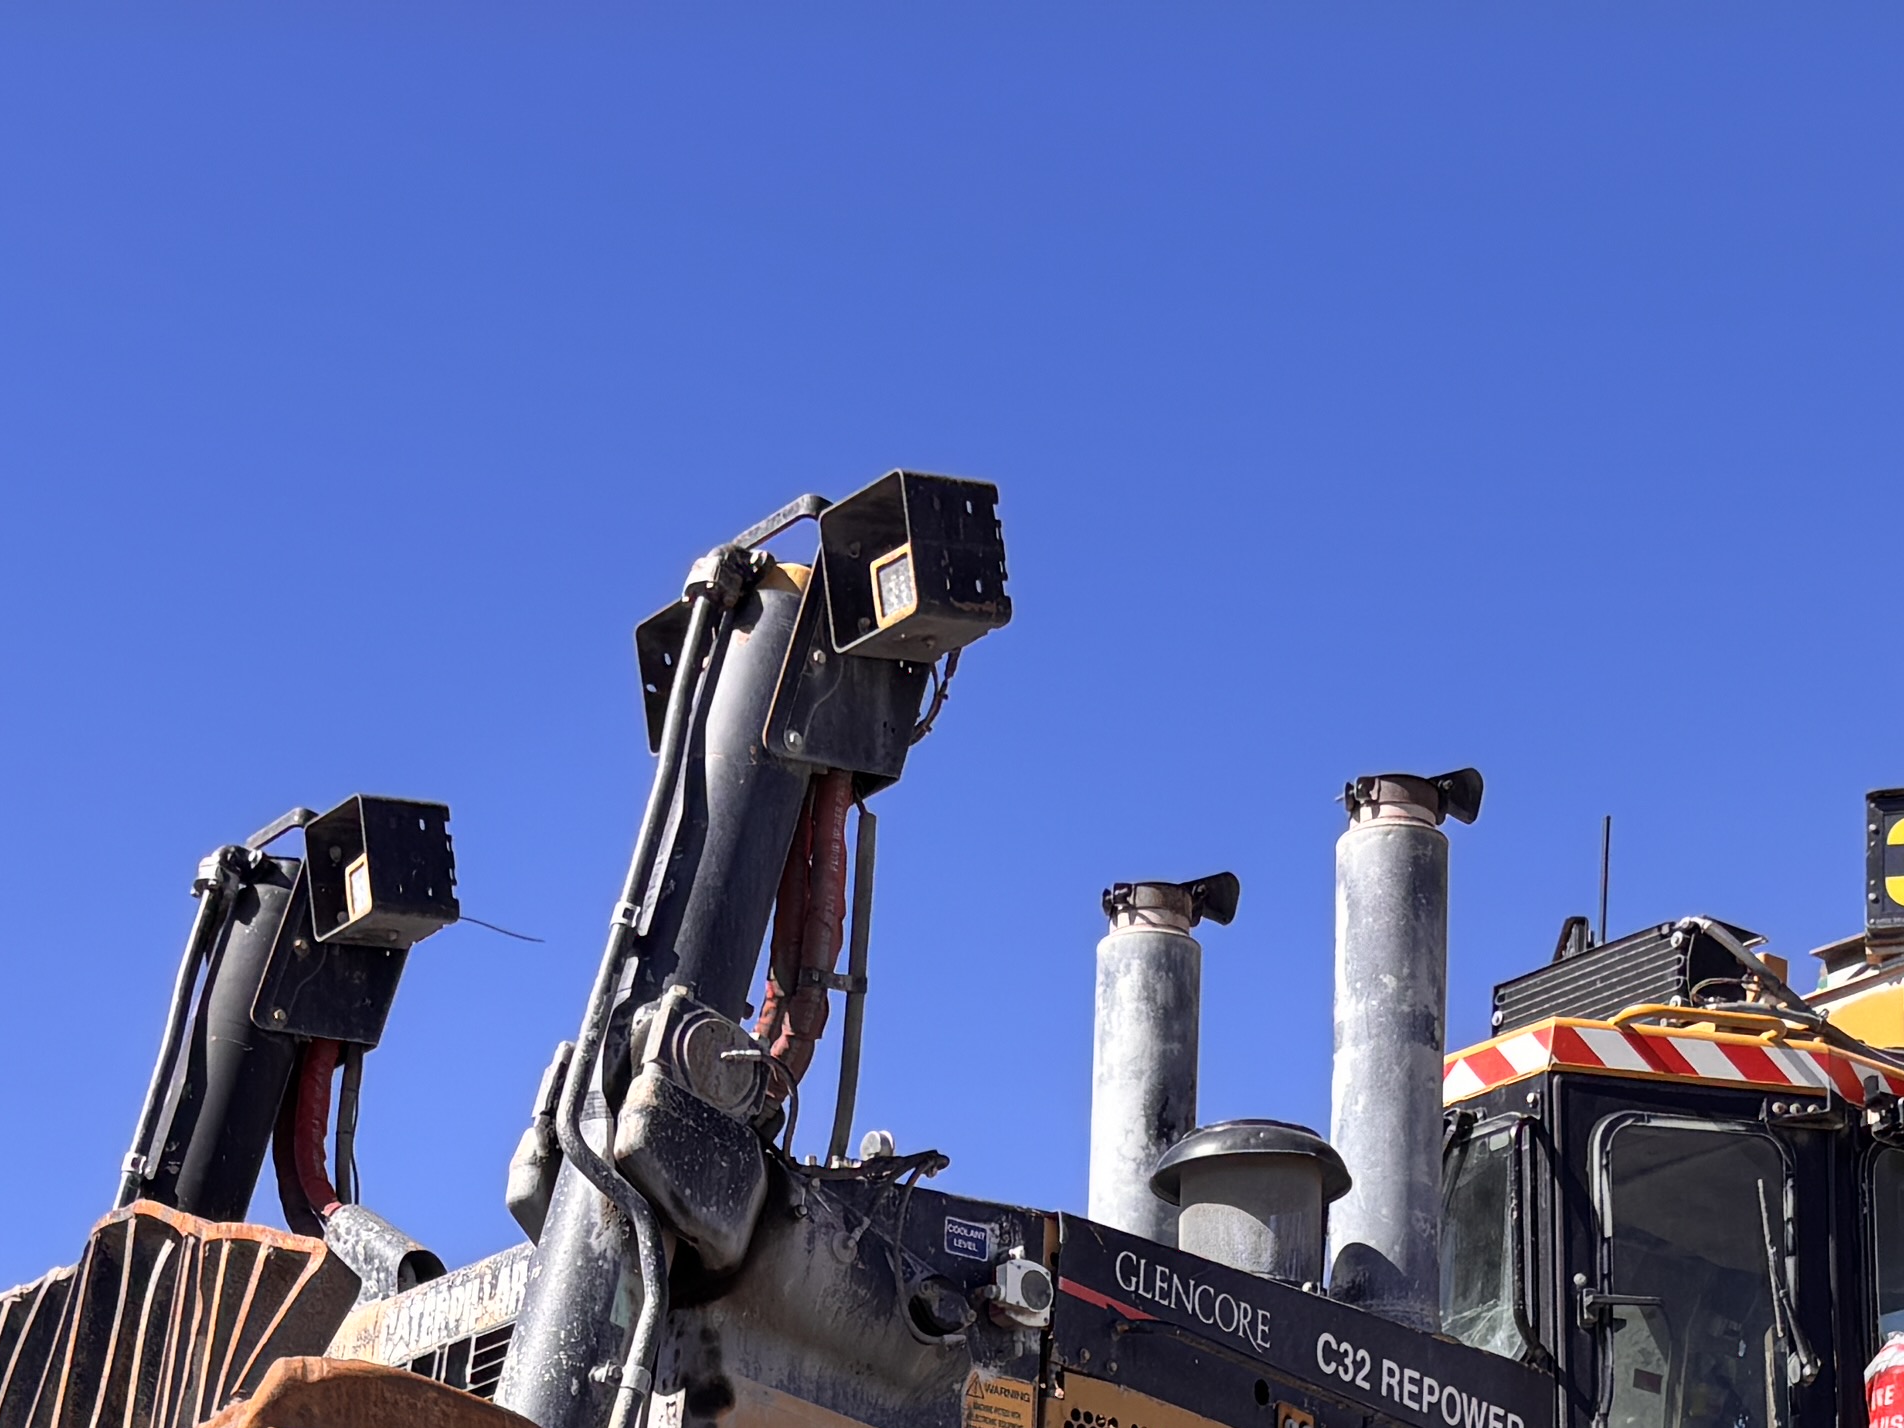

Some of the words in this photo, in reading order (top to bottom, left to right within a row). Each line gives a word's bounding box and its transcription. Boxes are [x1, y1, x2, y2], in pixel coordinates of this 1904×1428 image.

[947, 1223, 986, 1241] COOLANT
[953, 1238, 978, 1252] LEVEL
[1114, 1250, 1272, 1353] GLENCORE
[1316, 1331, 1371, 1390] C32
[984, 1382, 1031, 1403] WARNING
